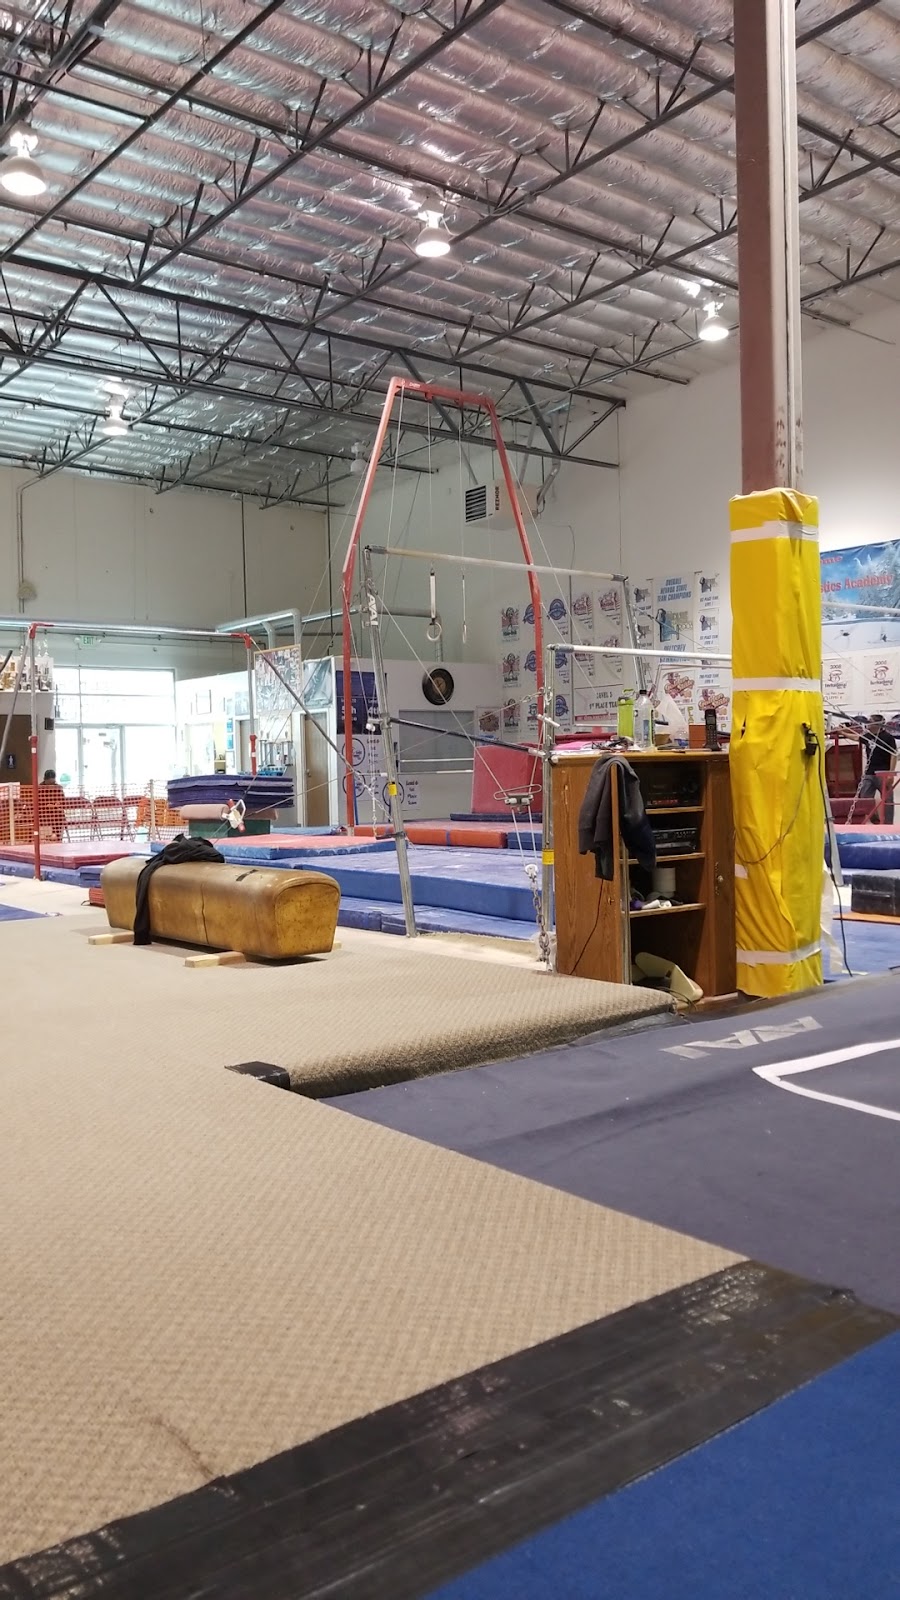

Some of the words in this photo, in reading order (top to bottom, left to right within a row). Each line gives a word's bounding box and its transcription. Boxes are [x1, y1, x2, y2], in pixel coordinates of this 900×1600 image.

[820, 580, 842, 593] stics
[844, 575, 894, 590] Academy
[668, 592, 692, 601] CHAMPIONS
